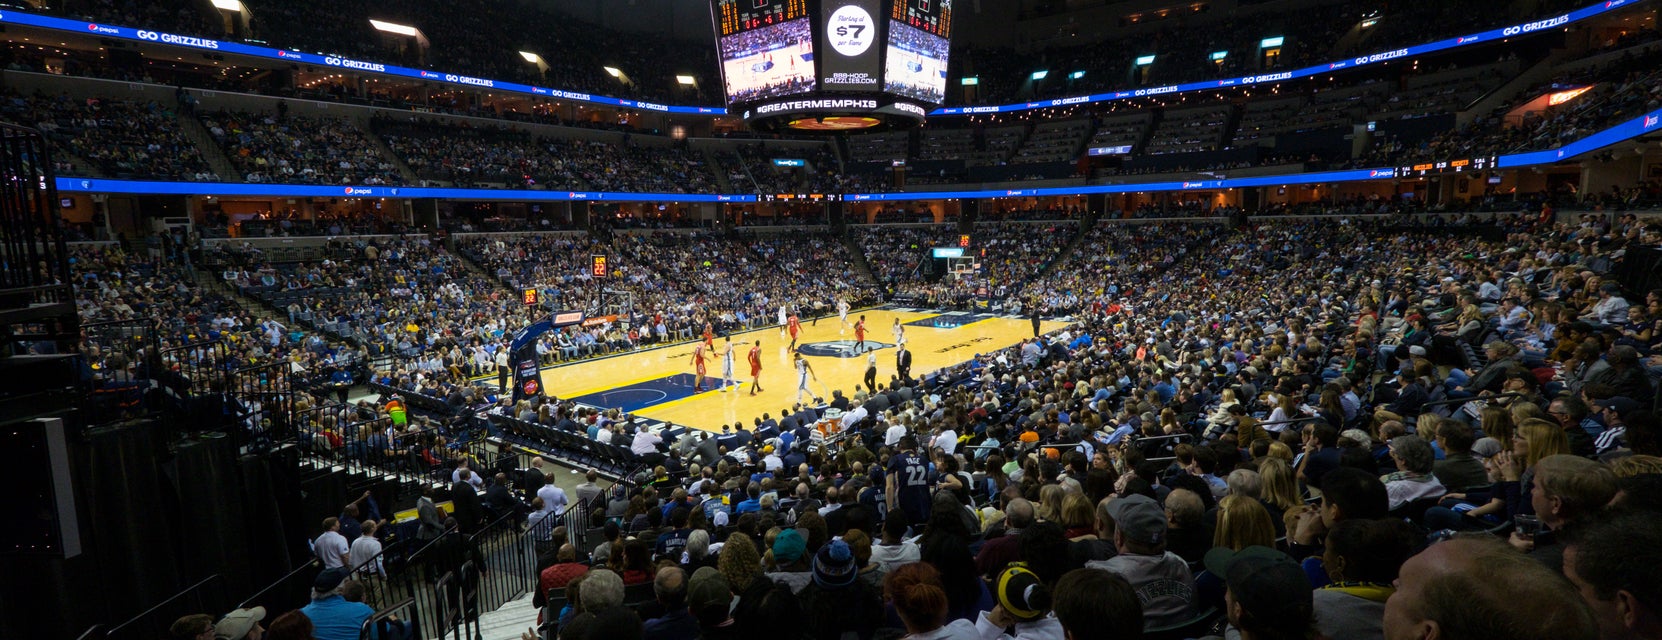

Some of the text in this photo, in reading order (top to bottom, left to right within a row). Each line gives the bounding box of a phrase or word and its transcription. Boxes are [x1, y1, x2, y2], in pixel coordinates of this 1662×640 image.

[837, 25, 866, 38] $7
[1503, 14, 1569, 36] GO GRIZZLIES
[137, 30, 218, 49] GO GRIZZLIES
[1355, 48, 1408, 65] GO GRIZZLIES
[325, 57, 385, 72] GO GRIZZLIES
[446, 74, 493, 87] GO GRIZZLIES
[1256, 72, 1292, 82] GRIZZLIES
[563, 92, 591, 101] GRIZZLIES
[1147, 86, 1177, 95] GRIZZLIES
[757, 100, 877, 114] #GREATERMEMPHIS
[594, 264, 604, 275] 22
[906, 457, 920, 465] PAGE
[906, 465, 927, 486] 22
